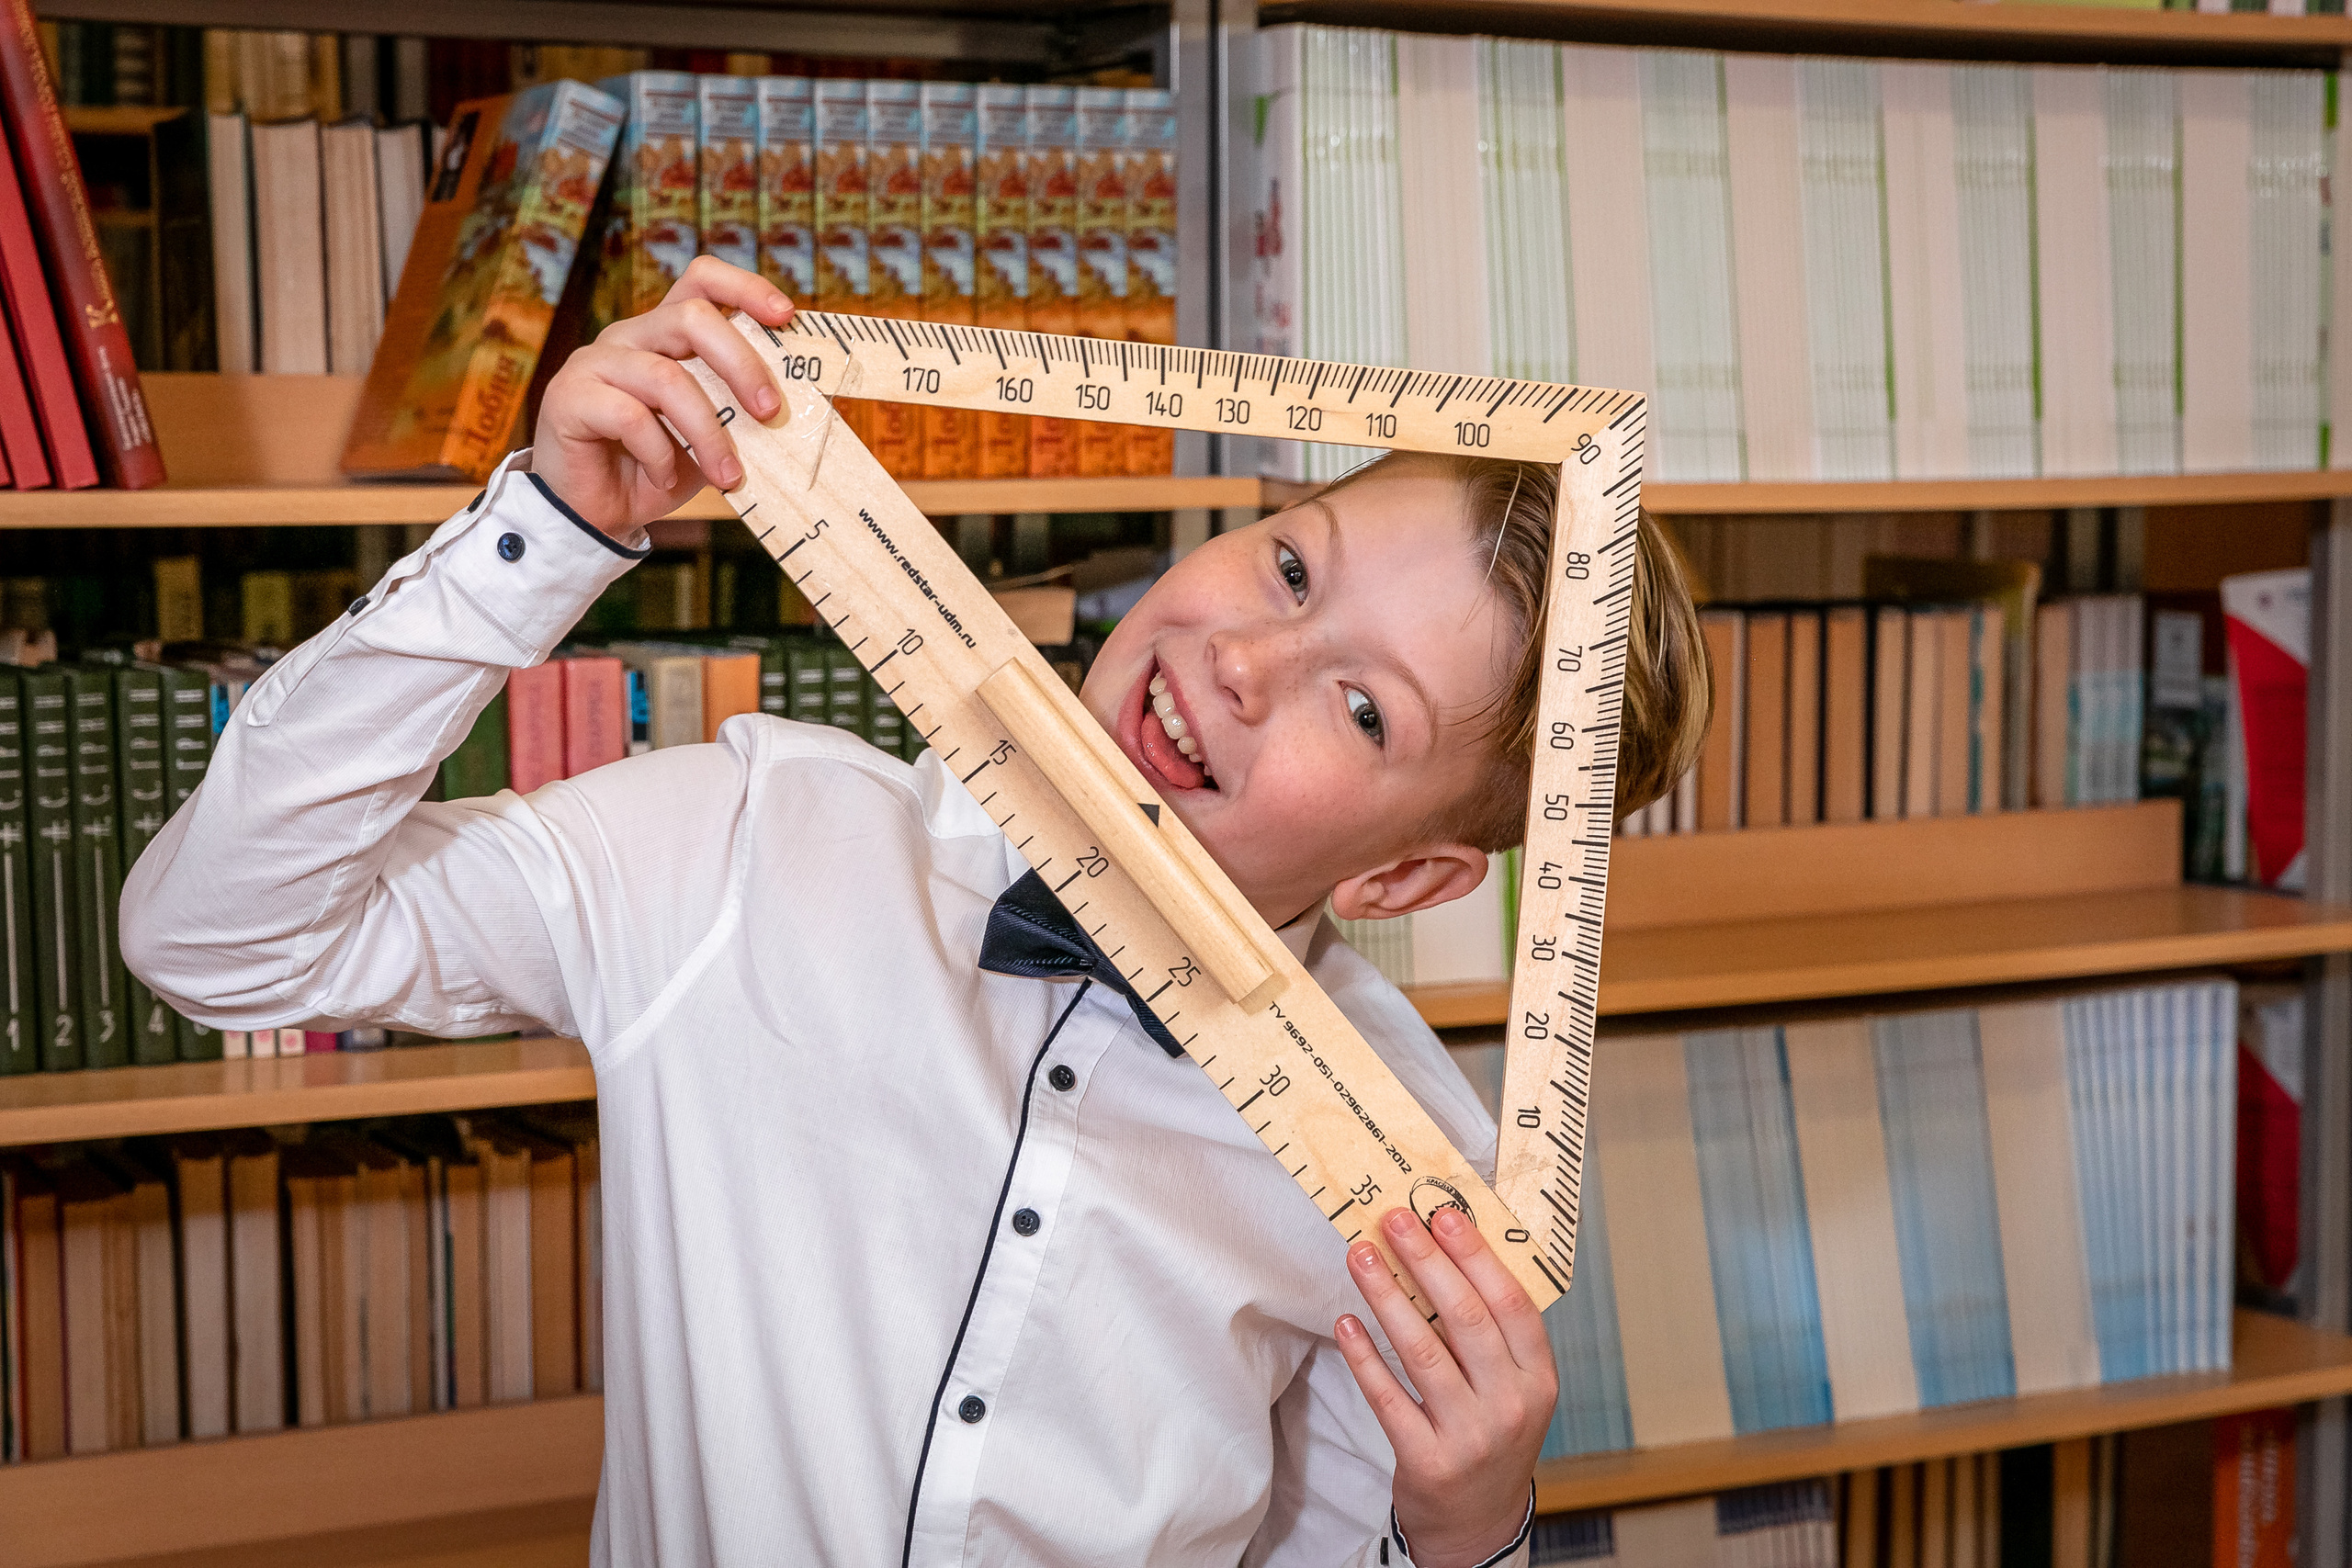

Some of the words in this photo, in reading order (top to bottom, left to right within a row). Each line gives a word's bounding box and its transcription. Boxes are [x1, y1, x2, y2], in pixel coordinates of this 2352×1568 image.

[783, 355, 821, 381] 180
[903, 367, 940, 393] 170
[997, 377, 1033, 402] 160
[1076, 385, 1110, 410] 150
[1147, 391, 1182, 417] 140
[1216, 399, 1250, 423] 130
[1286, 405, 1322, 431] 120
[1366, 413, 1396, 438] 110
[1454, 422, 1489, 447] 100
[1571, 434, 1600, 465] 90
[806, 519, 829, 539] 5
[1566, 552, 1590, 580] 80
[898, 629, 923, 655] 10
[1557, 646, 1582, 671] 70
[1551, 722, 1575, 750] 60
[989, 740, 1016, 764] 15
[1544, 794, 1568, 820] 50
[1076, 846, 1109, 877] 20
[1538, 862, 1562, 889] 40
[1532, 935, 1556, 961] 30
[1169, 957, 1201, 987] 25
[54, 1014, 74, 1046] 2
[98, 1010, 116, 1043] 3
[147, 1003, 165, 1035] 4
[1525, 1011, 1549, 1040] 20
[6, 1018, 19, 1052] 1
[1260, 1065, 1290, 1096] 30
[1283, 1021, 1412, 1175] 9692-051-02962861-2012
[1517, 1106, 1541, 1128] 10
[1351, 1175, 1382, 1205] 35
[1505, 1229, 1530, 1243] 0
